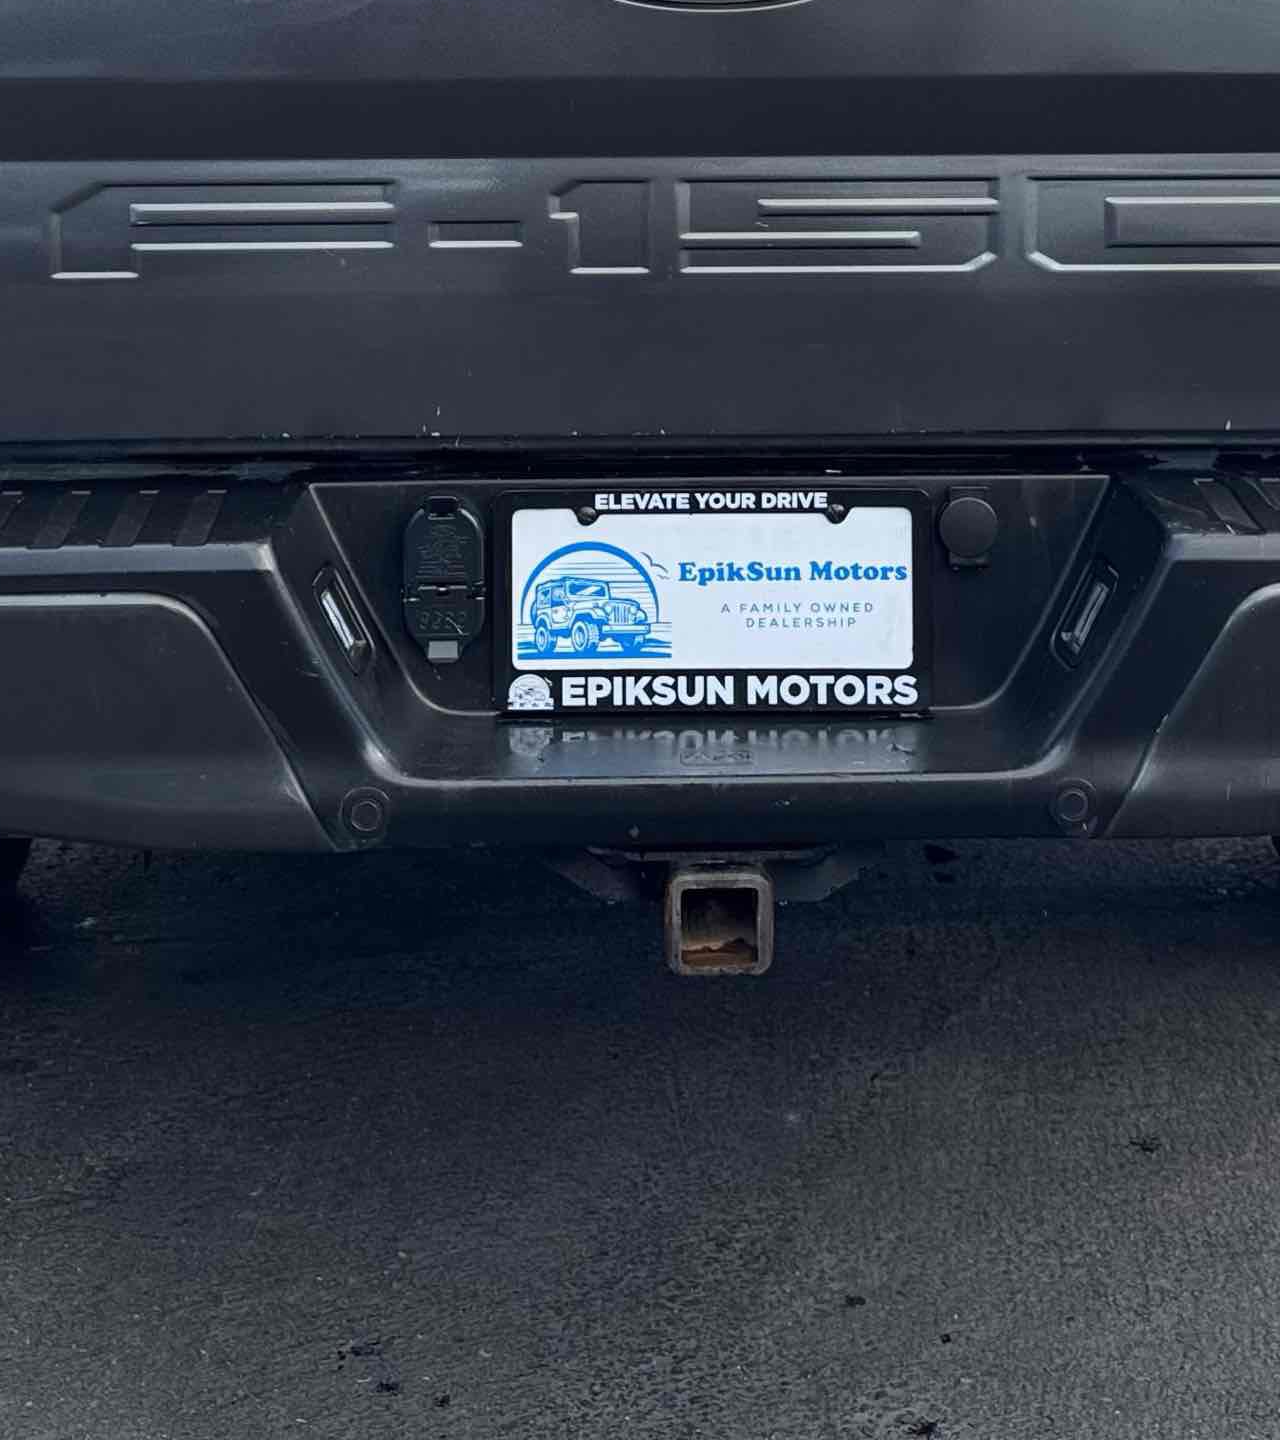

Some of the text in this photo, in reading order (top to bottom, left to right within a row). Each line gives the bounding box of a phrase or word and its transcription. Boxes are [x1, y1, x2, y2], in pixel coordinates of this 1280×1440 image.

[594, 492, 828, 510] ELEVATE YOUR DRIVE
[678, 561, 908, 586] EpikSun Motors
[720, 602, 874, 614] A FAMILY OWNED
[745, 616, 858, 628] DEALERSHIP
[561, 674, 919, 707] EPIKSUN MOTORS
